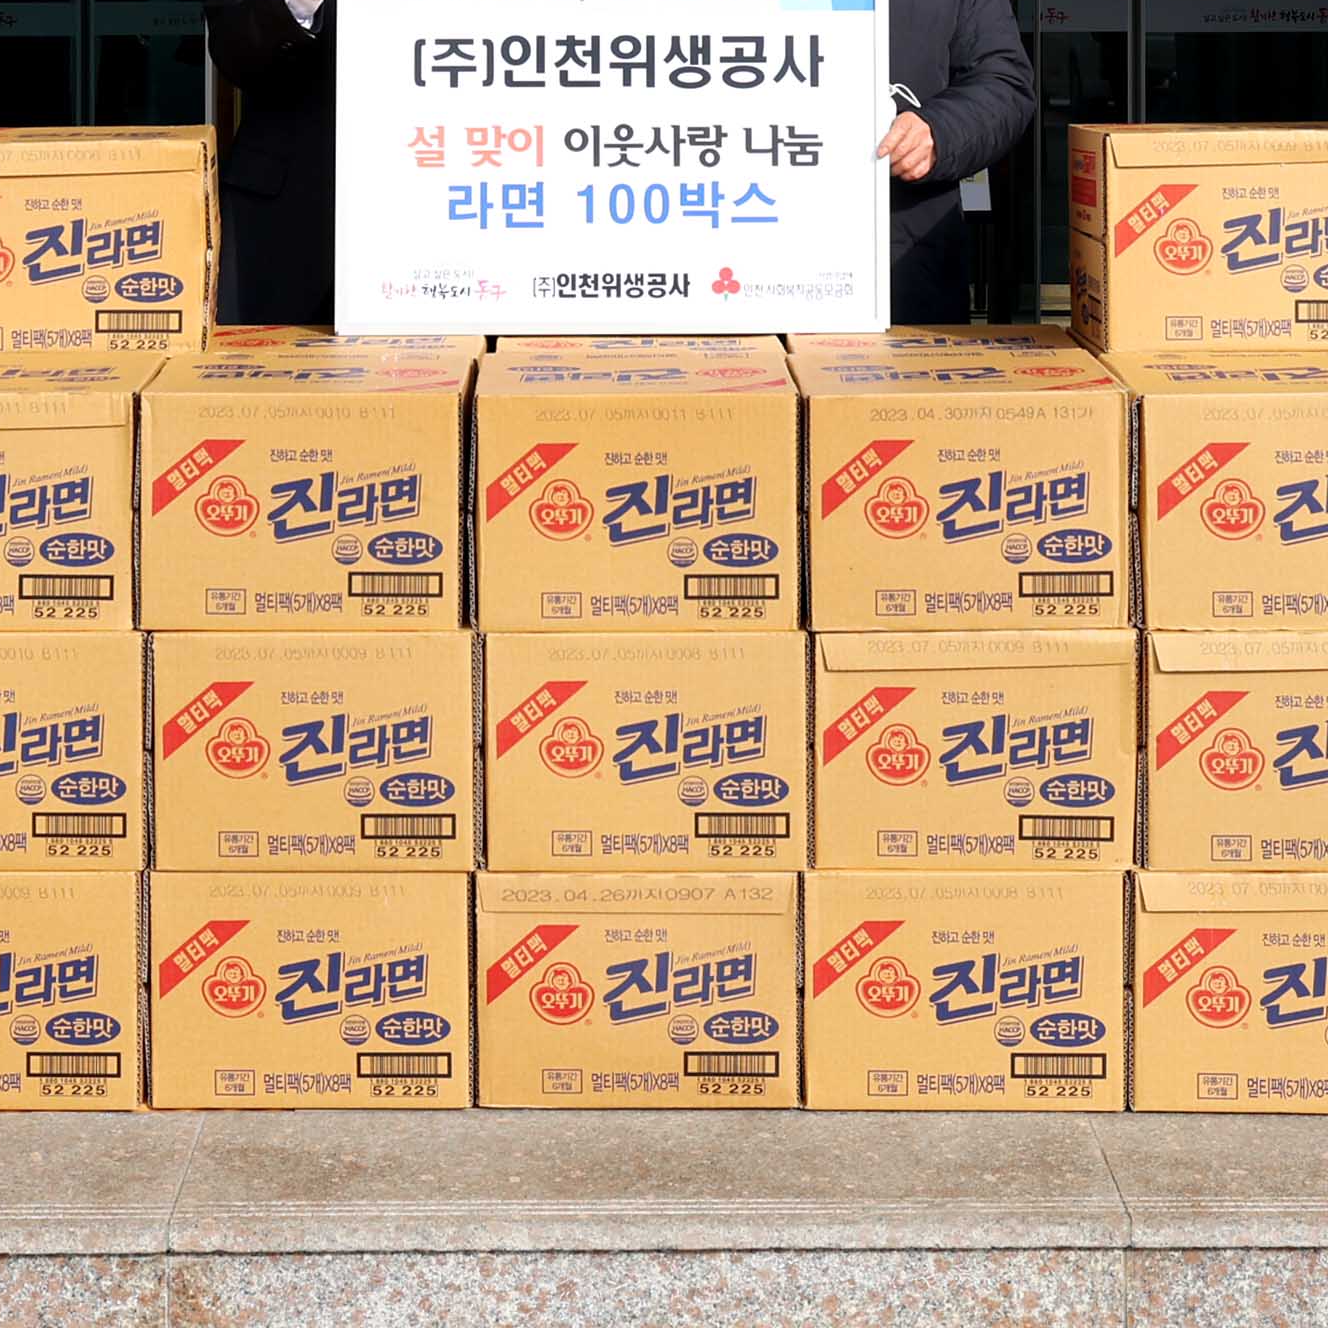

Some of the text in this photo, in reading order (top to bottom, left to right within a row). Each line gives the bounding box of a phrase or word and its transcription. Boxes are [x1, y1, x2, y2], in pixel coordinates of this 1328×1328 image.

[407, 124, 823, 168] 설 맞이 이웃사랑 나눔
[447, 182, 779, 230] 라면 100박스
[23, 217, 165, 286] 진라면
[532, 272, 690, 299] (주)인천위생공사
[421, 283, 471, 299] 행복도시
[474, 279, 507, 301] 동구
[268, 470, 421, 545] 진라면
[603, 474, 757, 547] 진라면
[937, 469, 1091, 544] 진라면
[279, 712, 433, 787] 진라면
[613, 711, 767, 786] 진라면
[939, 709, 1097, 789] 진라면
[275, 951, 429, 1025] 진라면
[500, 934, 548, 979] 멀티팩
[603, 949, 758, 1027] 진라면
[930, 952, 1084, 1027] 진라면
[542, 991, 583, 1011] 오뚜기
[709, 1016, 772, 1038] 순한맛
[700, 1083, 764, 1095] 52 225
